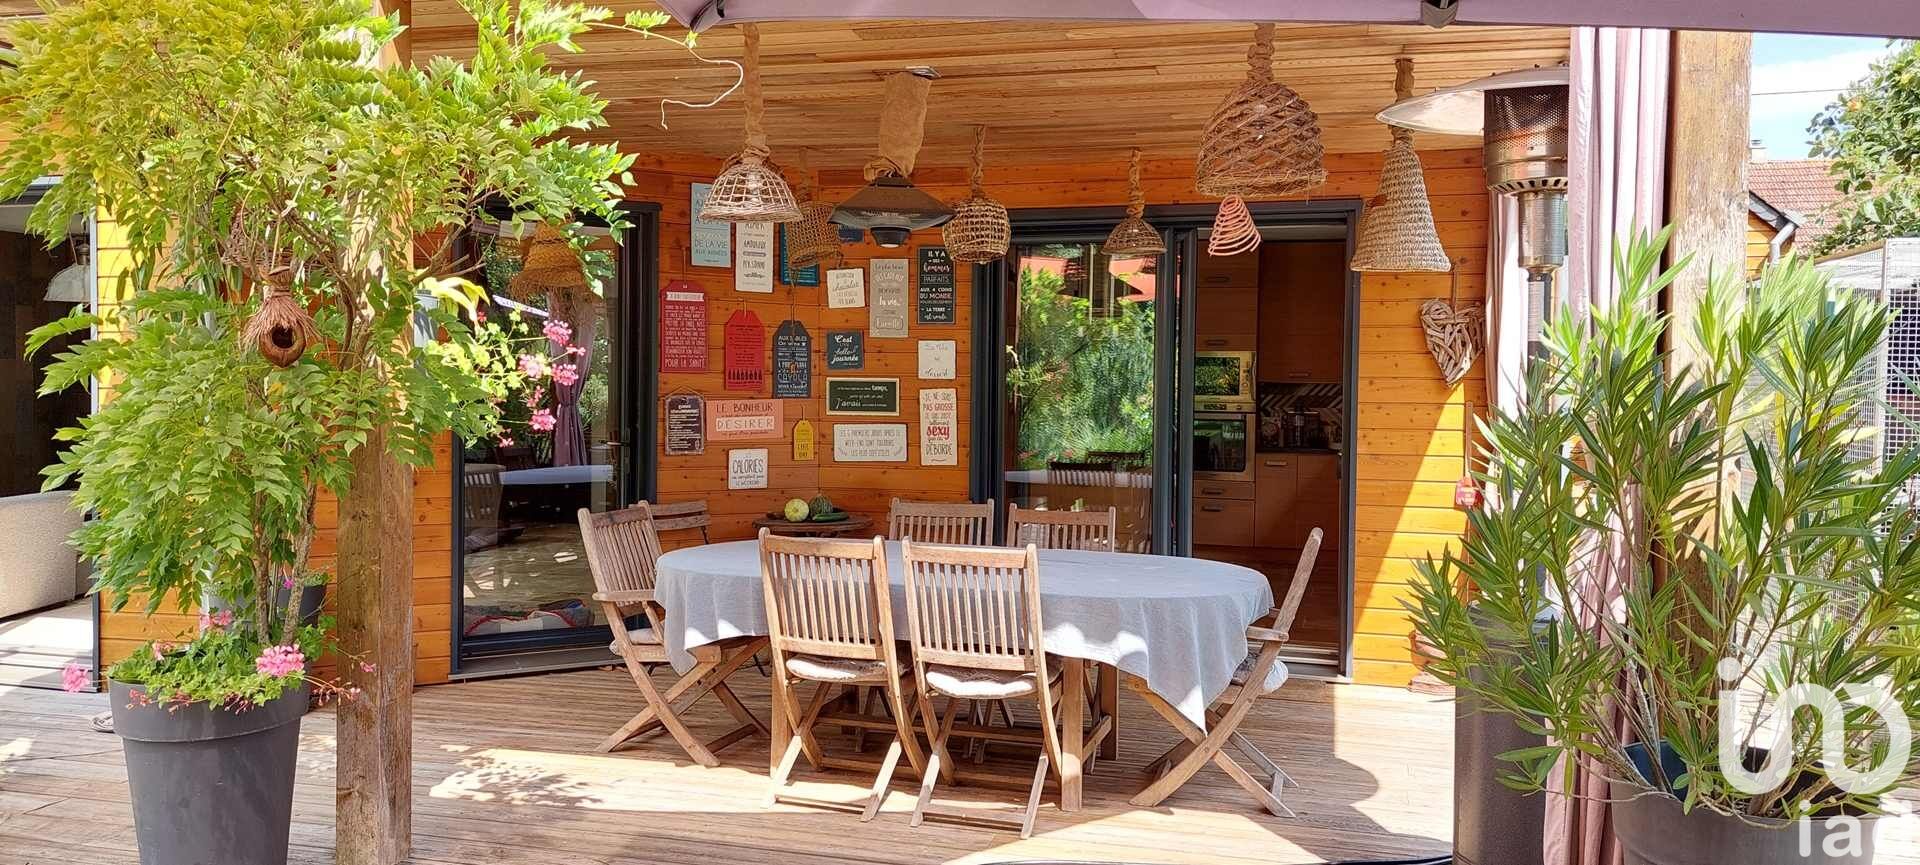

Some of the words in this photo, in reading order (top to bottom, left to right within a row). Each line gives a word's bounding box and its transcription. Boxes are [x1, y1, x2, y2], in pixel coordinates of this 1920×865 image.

[716, 402, 726, 413] LE
[733, 402, 774, 413] BONHEUR
[926, 426, 950, 440] sexy
[732, 459, 763, 474] CALORIES
